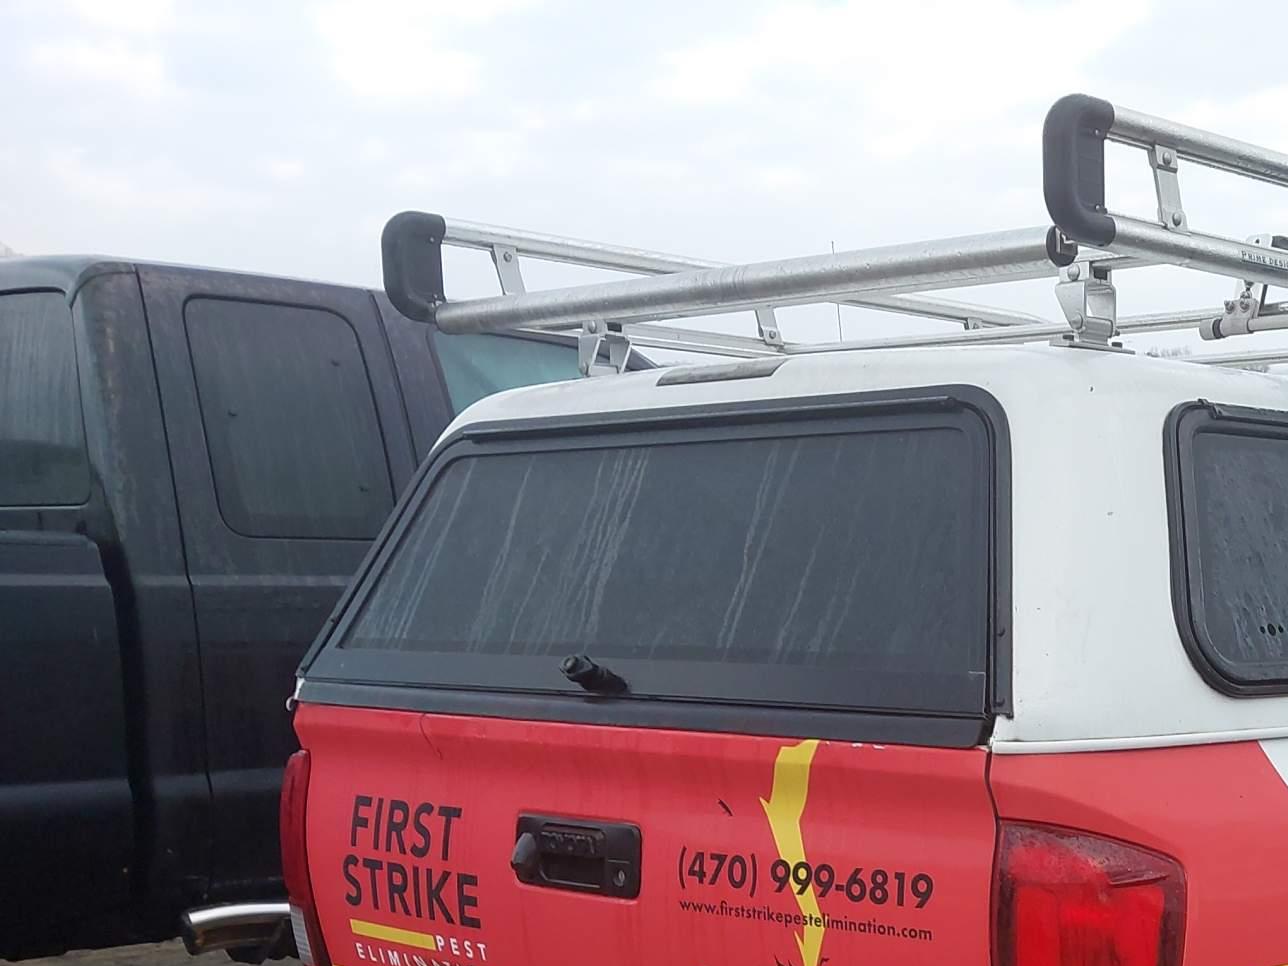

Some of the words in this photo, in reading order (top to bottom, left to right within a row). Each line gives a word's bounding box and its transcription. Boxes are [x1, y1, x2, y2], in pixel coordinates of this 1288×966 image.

[351, 795, 463, 861] FIRST
[343, 854, 482, 929] STRIKE
[678, 846, 758, 898] (470)
[770, 859, 934, 909] 999-6819
[435, 935, 488, 962] PEST
[679, 899, 933, 941] www.firststrikepestelimination.com
